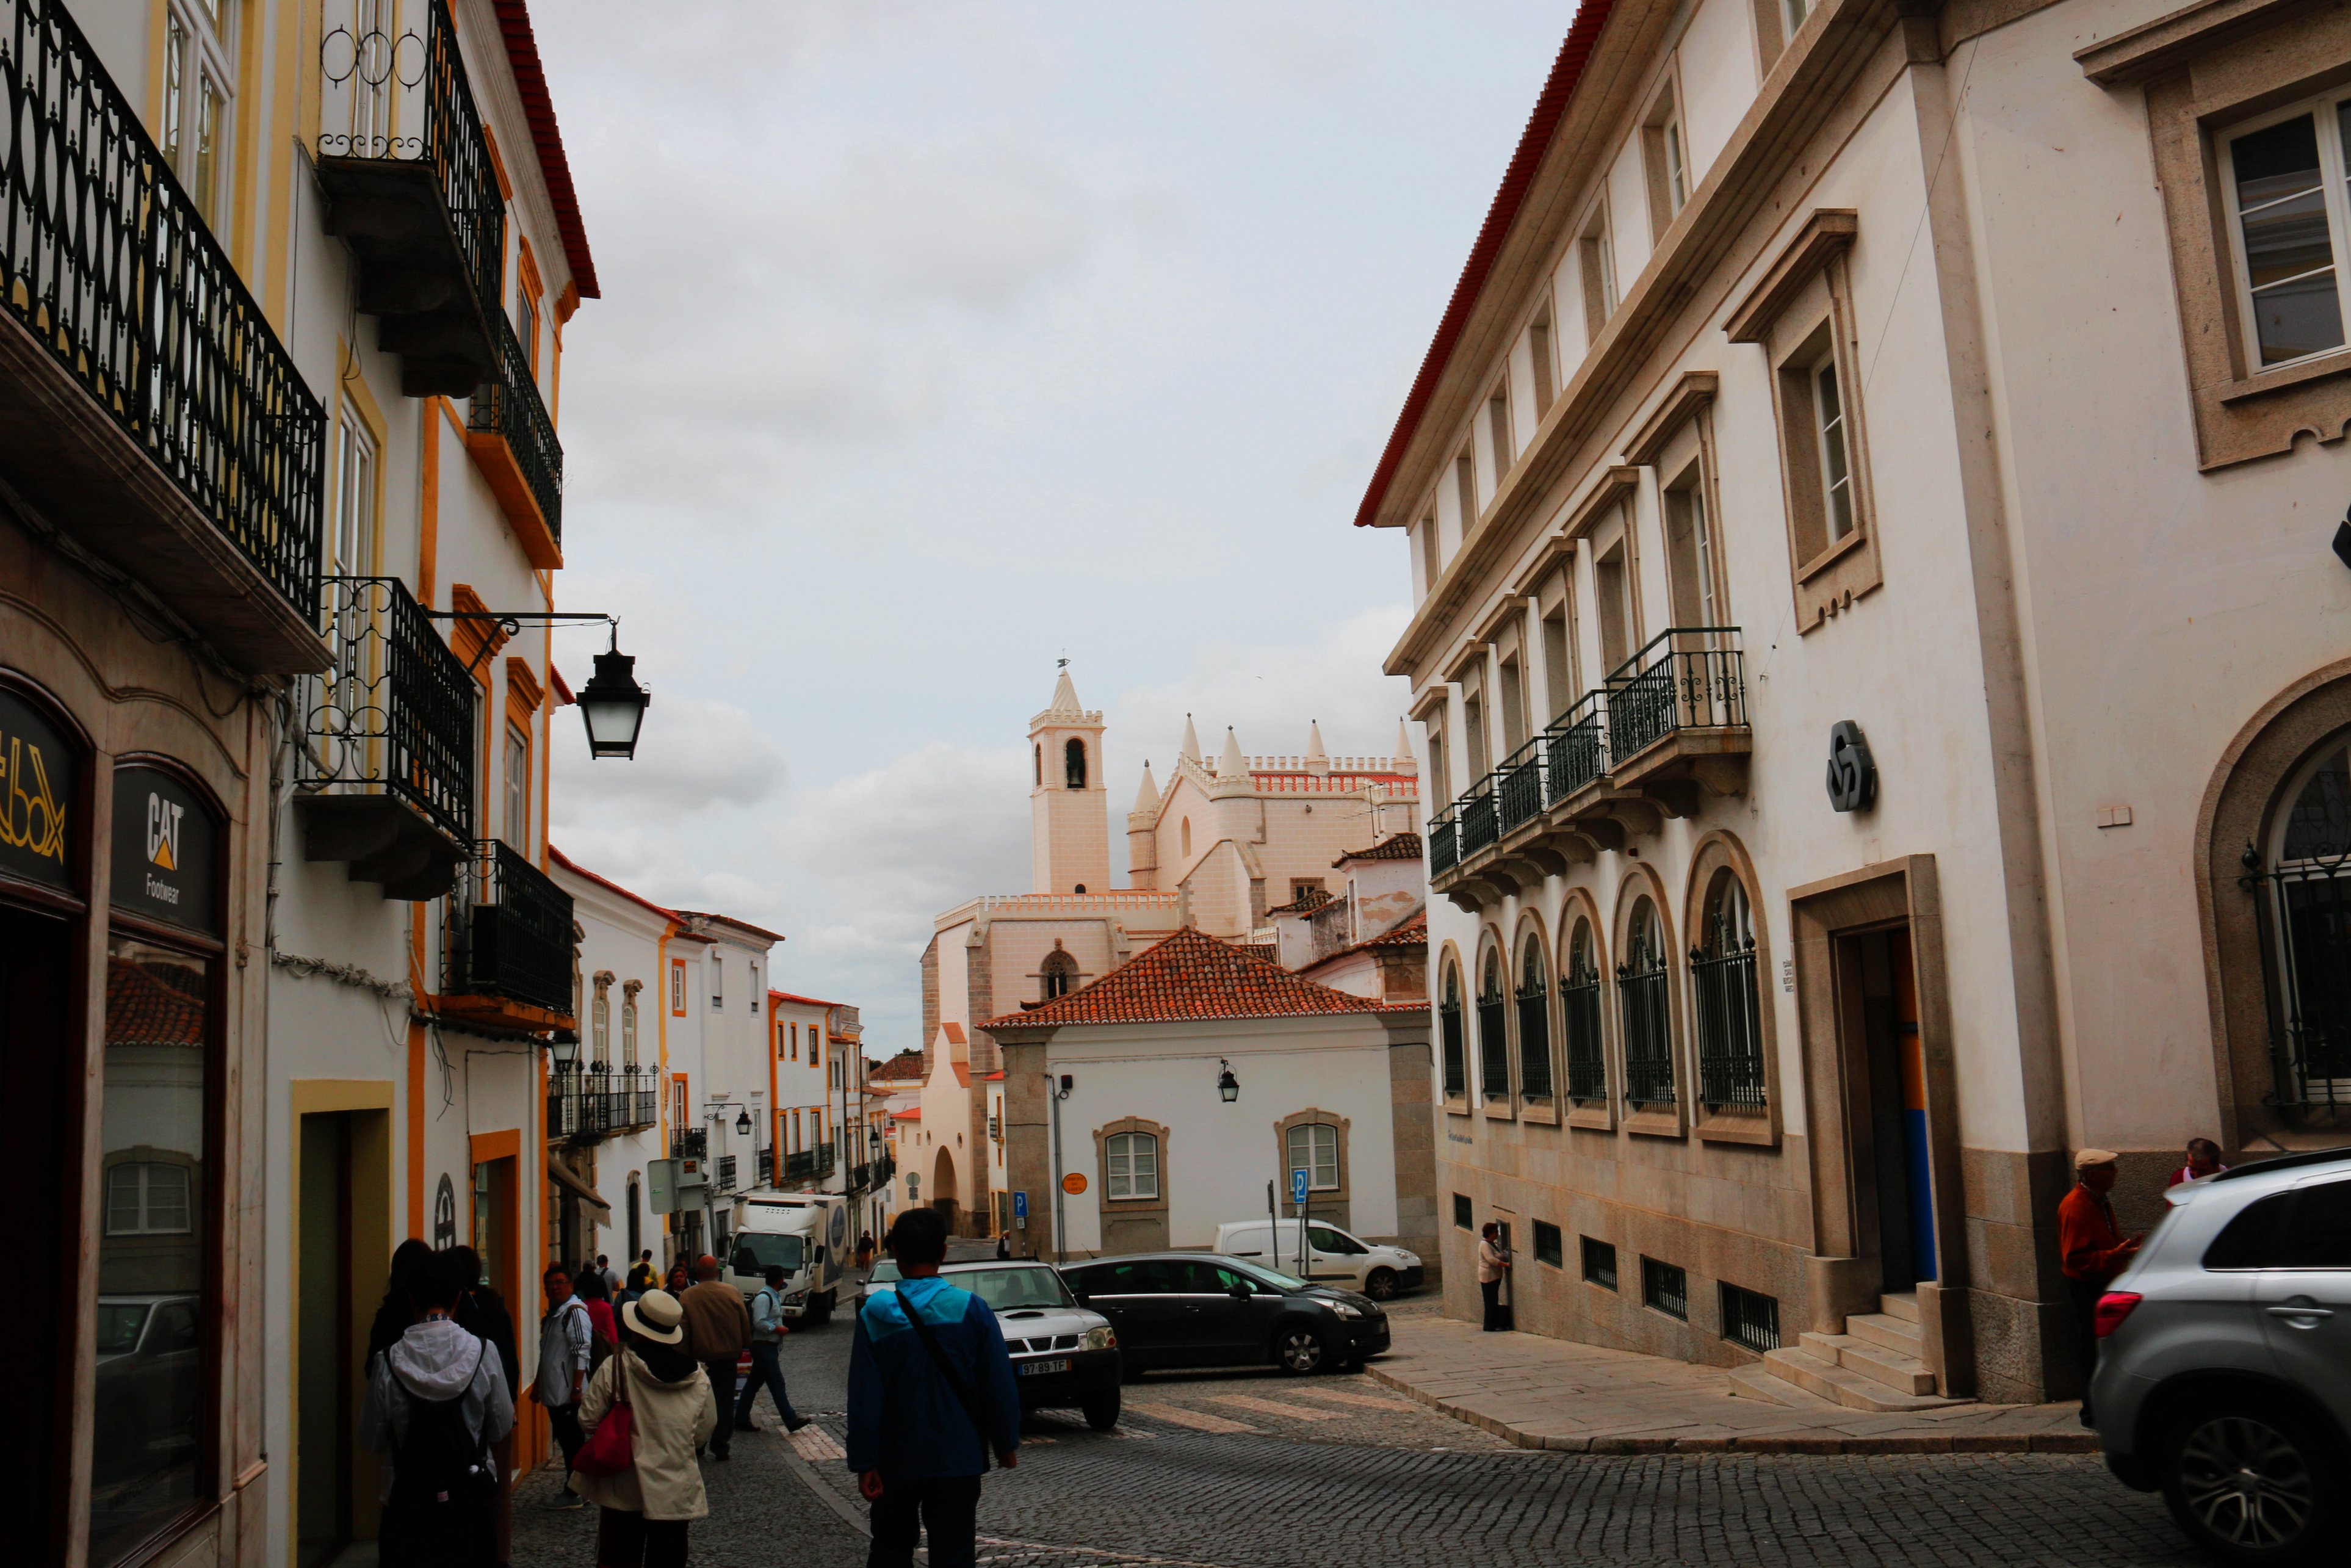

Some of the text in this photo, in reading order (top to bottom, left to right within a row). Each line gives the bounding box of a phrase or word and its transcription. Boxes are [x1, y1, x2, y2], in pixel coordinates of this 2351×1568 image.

[147, 792, 182, 870] CAT
[146, 873, 179, 905] Footwear
[1297, 1174, 1304, 1199] P
[1017, 1196, 1024, 1212] P
